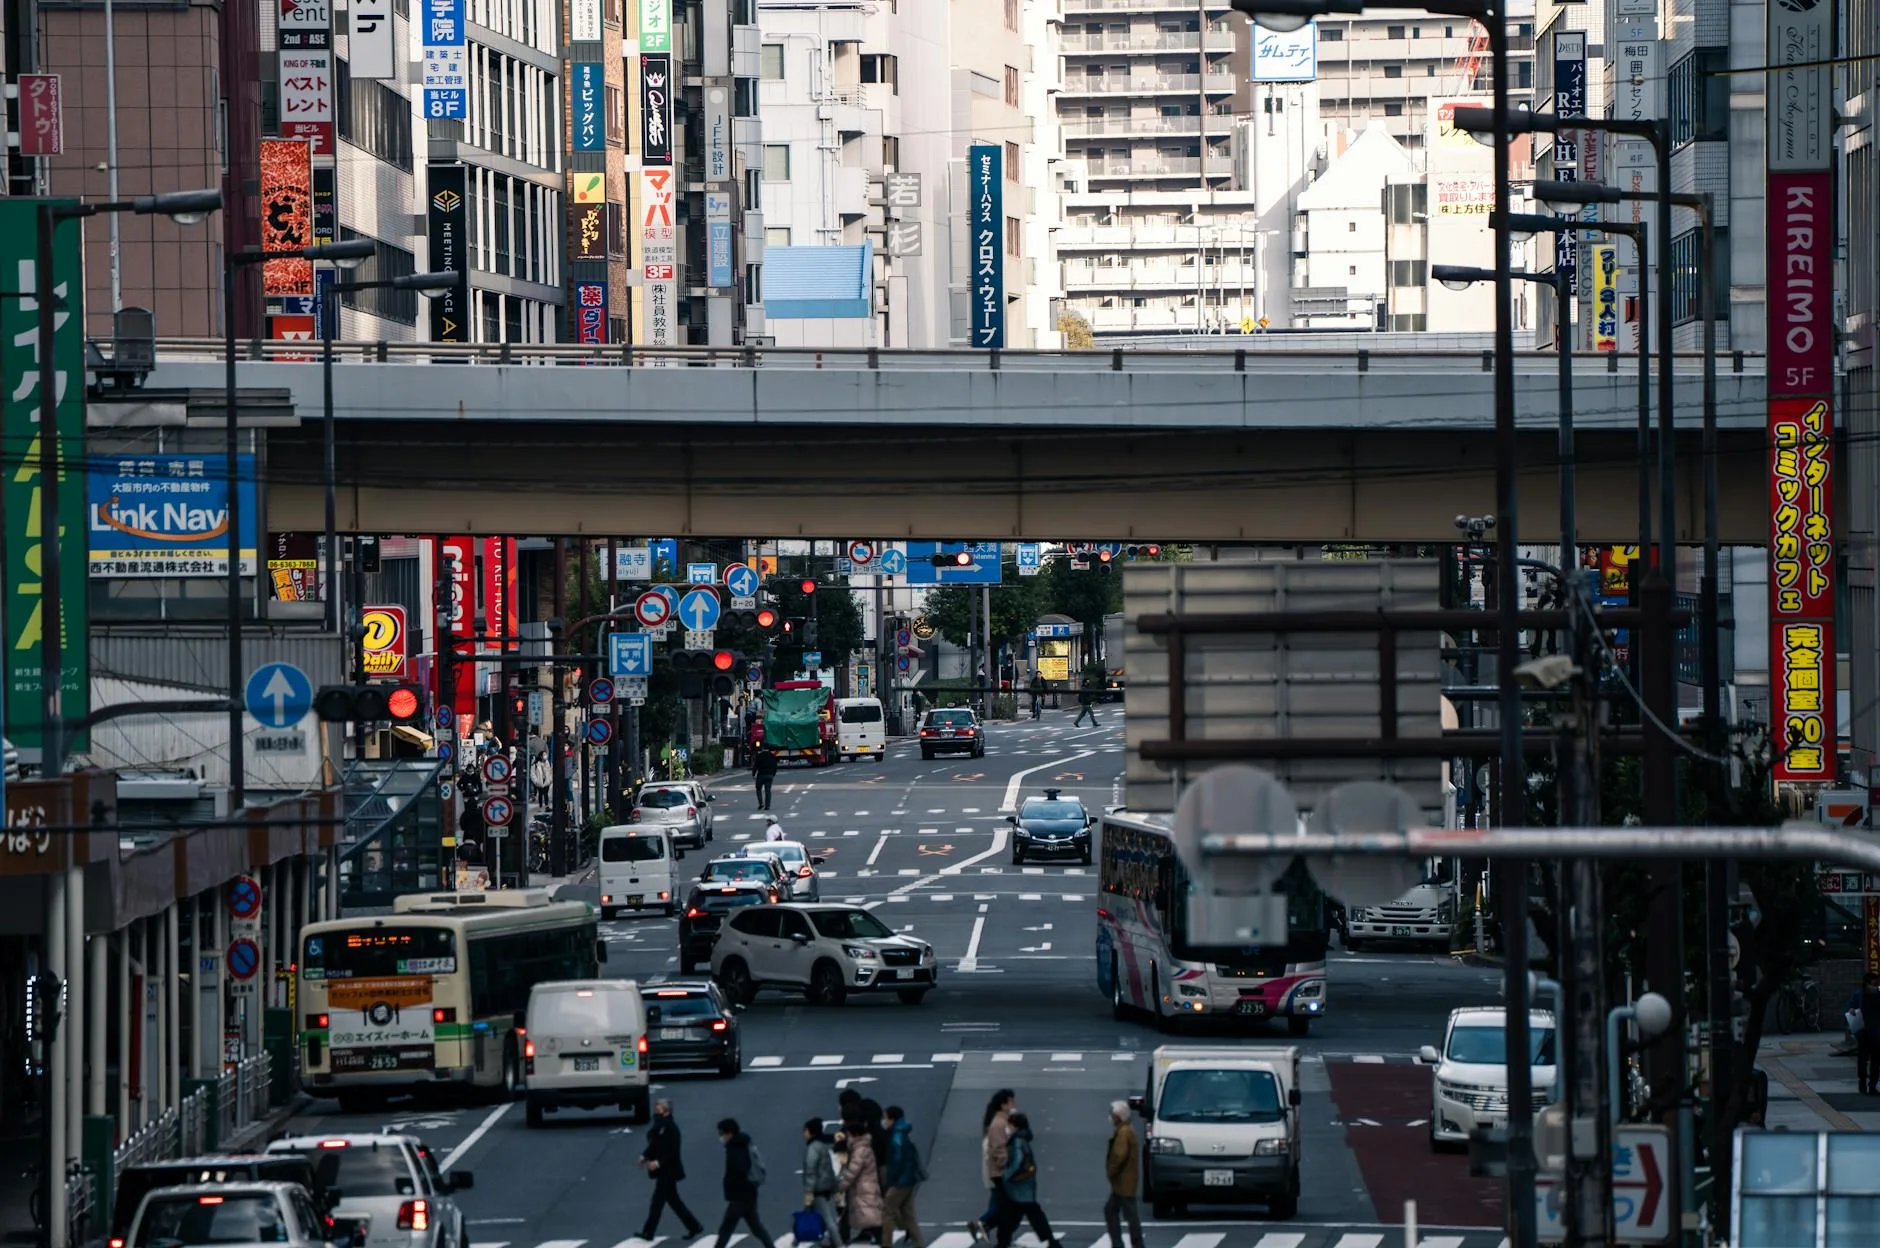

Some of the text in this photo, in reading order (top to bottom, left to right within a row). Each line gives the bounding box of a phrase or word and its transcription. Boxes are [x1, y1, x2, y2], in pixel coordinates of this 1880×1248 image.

[431, 0, 454, 41] 学院
[284, 34, 301, 45] 2nd
[1631, 28, 1643, 37] 5F
[646, 35, 665, 47] 2F
[426, 50, 462, 59] 建築士
[1624, 46, 1648, 57] 梅田
[430, 63, 457, 71] 宅建
[285, 77, 327, 91] ベスト
[426, 76, 462, 84] 施工管理
[431, 90, 459, 99] 当ビル
[1630, 61, 1643, 121] 囲センタ
[287, 98, 328, 112] レント
[431, 101, 459, 116] 8F
[30, 79, 50, 153] タトゥー
[582, 89, 595, 147] ビッグバン
[1779, 85, 1803, 159] Aoyama
[295, 124, 319, 133] 当ビル
[1630, 154, 1643, 162] 4F
[980, 155, 992, 222] セミナーハウス
[644, 170, 671, 226] マッハ
[890, 176, 920, 254] 若杉
[645, 228, 672, 239] 模型
[647, 265, 672, 279] 3F
[1786, 186, 1813, 353] KIREIMO
[582, 287, 602, 306] 薬
[1786, 367, 1815, 386] 5F
[112, 482, 210, 493] 大阪市内の不動産物件
[1803, 403, 1829, 598] インターネット
[91, 500, 229, 531] Link Navi
[1775, 422, 1801, 613] コミックカフェ
[363, 652, 404, 672] Daily
